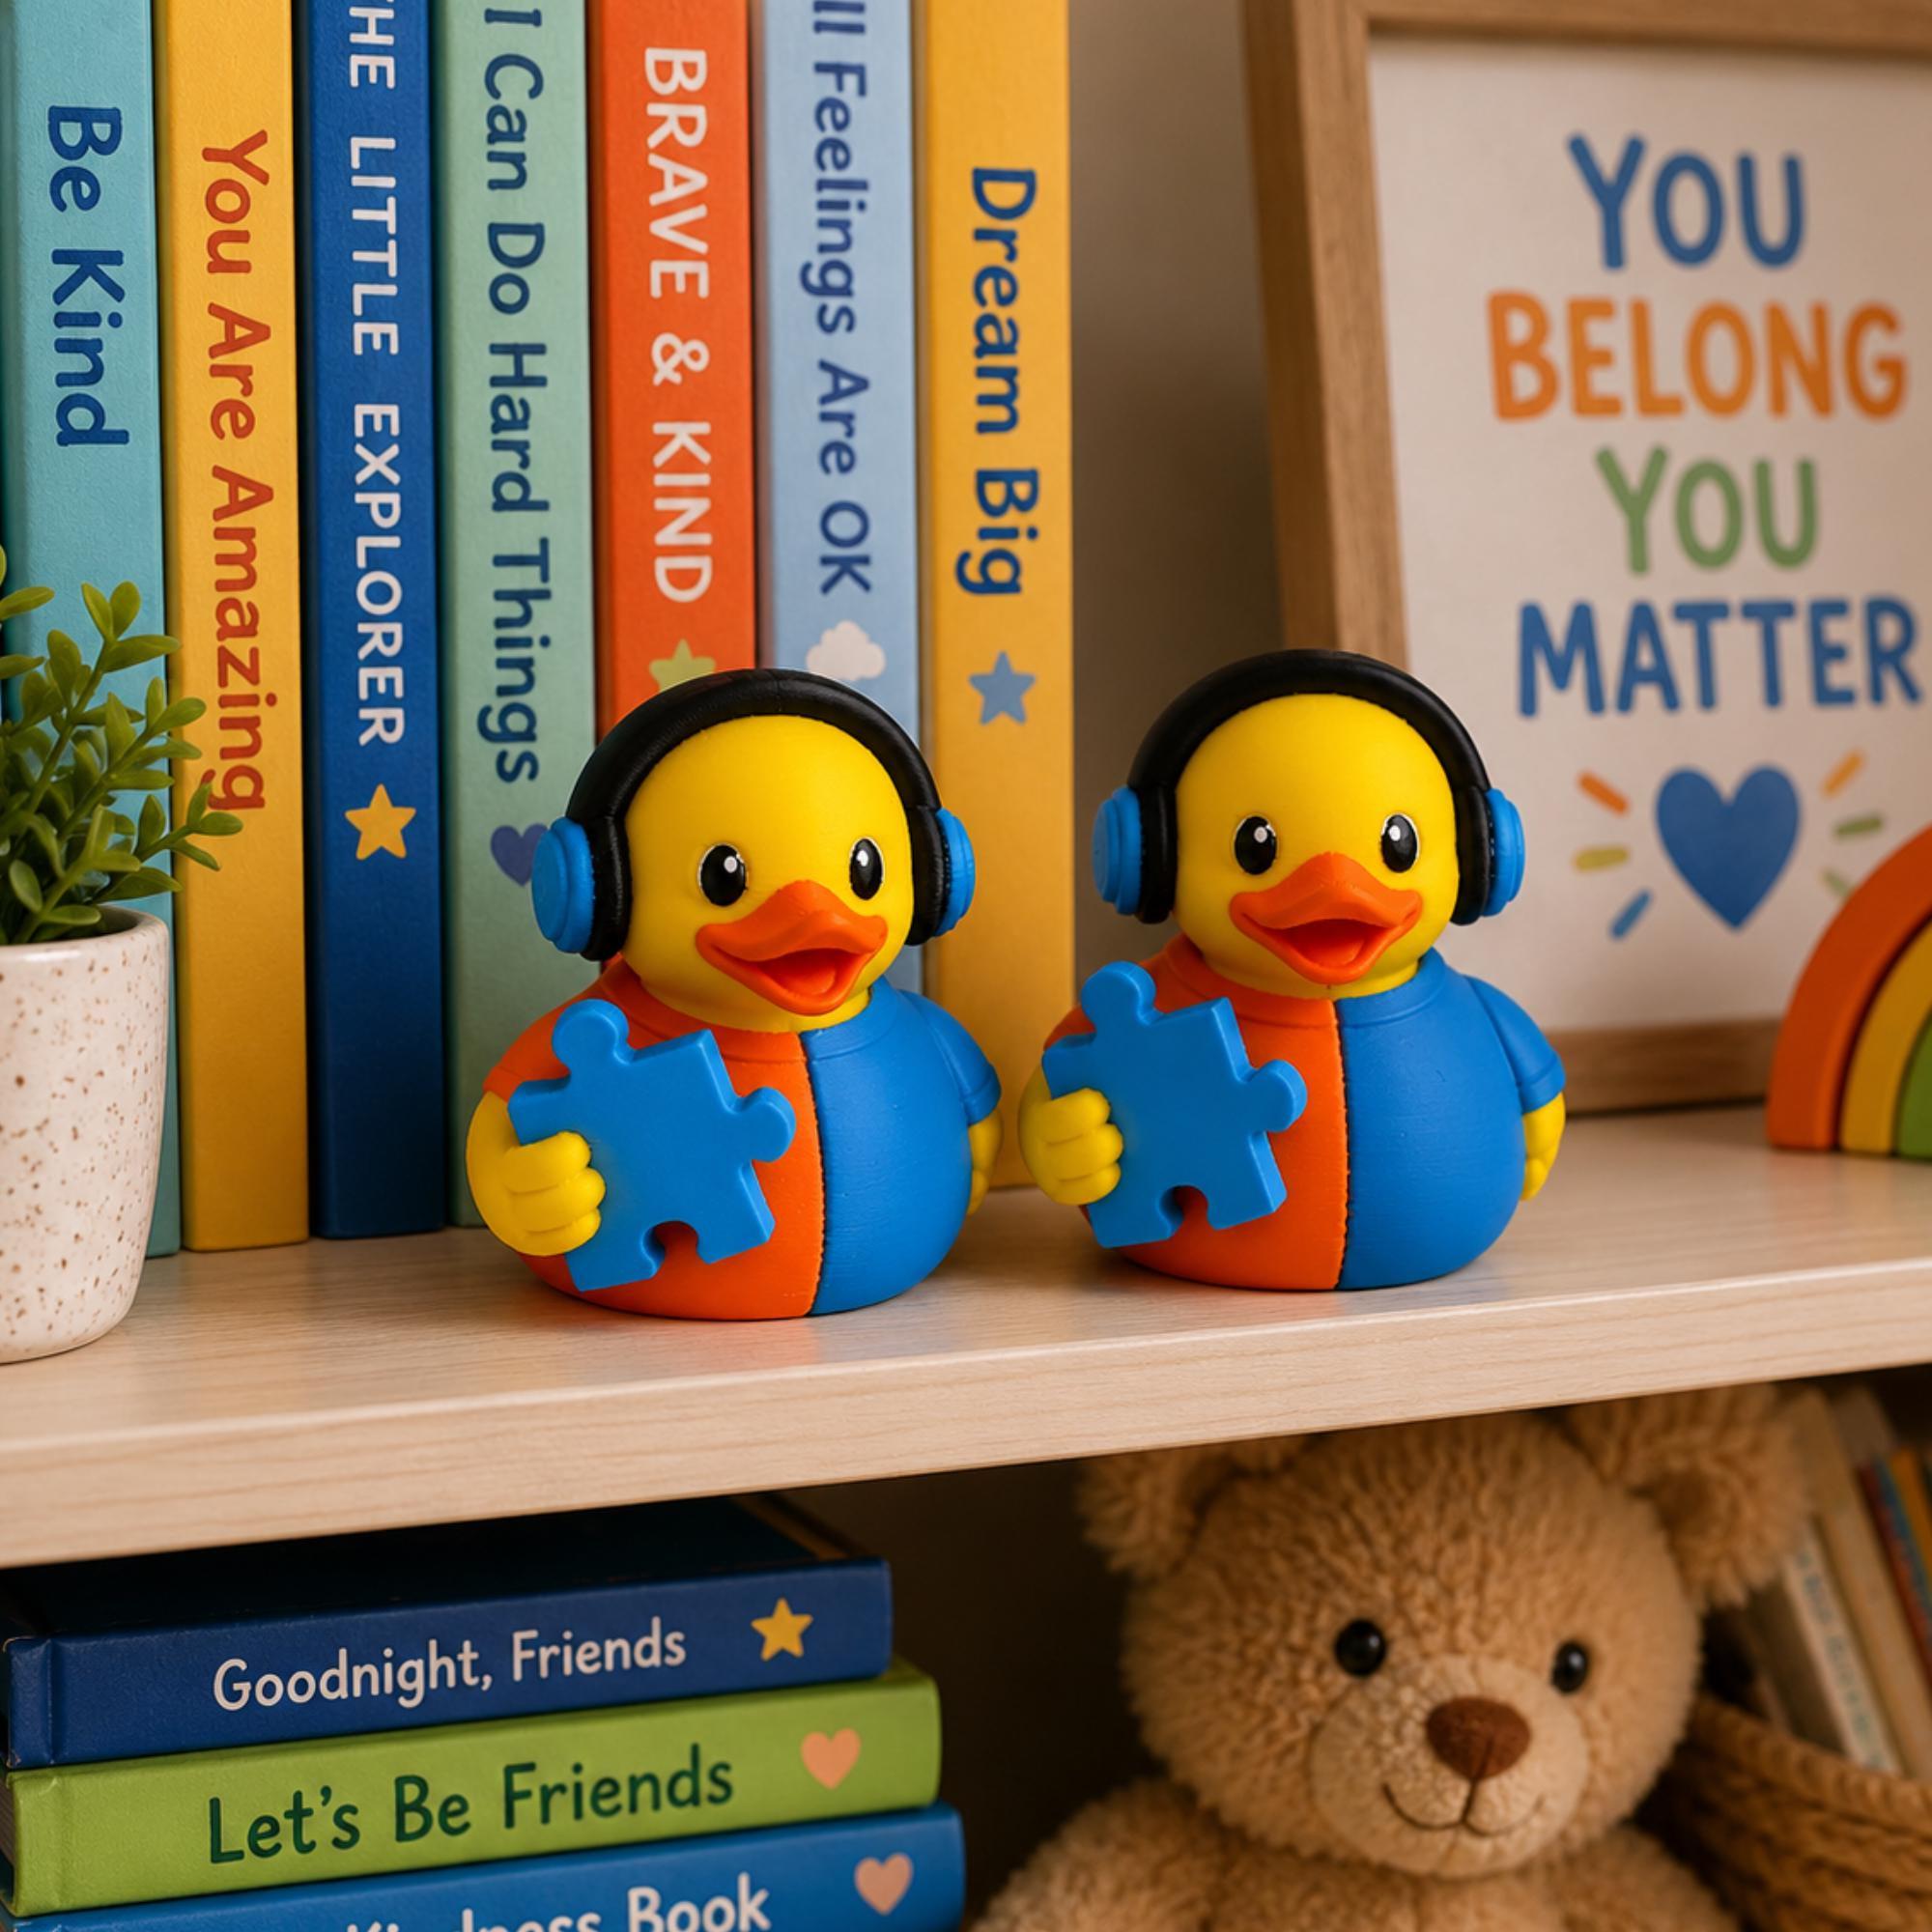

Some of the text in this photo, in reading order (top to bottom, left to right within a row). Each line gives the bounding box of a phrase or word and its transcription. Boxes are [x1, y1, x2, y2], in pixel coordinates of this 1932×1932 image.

[48, 105, 129, 446] Be Kind
[800, 0, 870, 594] ll Feelings Are OK
[1567, 133, 1805, 271] YOU
[349, 0, 404, 745] HE LITTLE EXPLORER
[477, 9, 552, 783] I Can Do Hard Things
[645, 48, 712, 602] BRAVE & KIND
[955, 168, 1038, 595] Dream Big
[1487, 291, 1910, 423] BELONG
[200, 129, 277, 810] You Are Amazing
[1596, 445, 1820, 577] YOU
[1518, 595, 1922, 719] MATTER
[214, 1617, 685, 1710] Goodnight, Friends
[210, 1743, 733, 1863] Let’s Be Friends
[629, 1873, 769, 1932] Book
